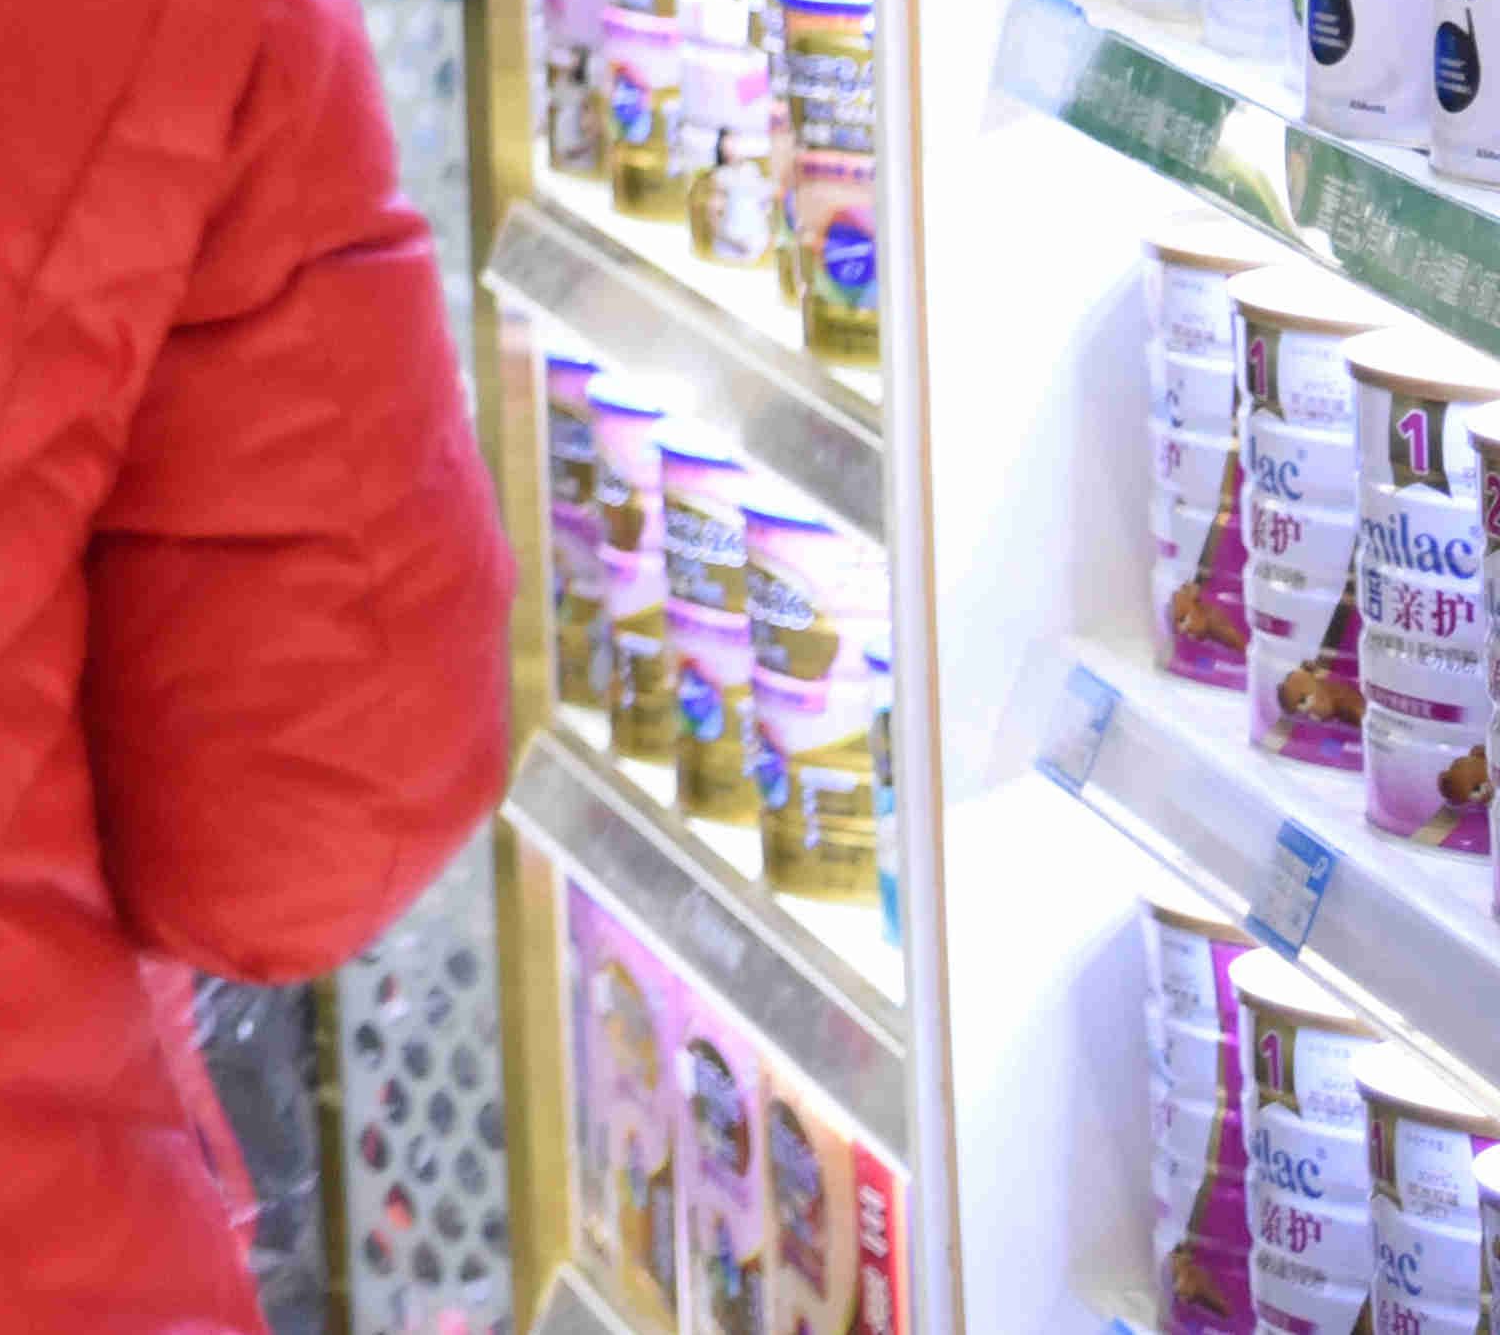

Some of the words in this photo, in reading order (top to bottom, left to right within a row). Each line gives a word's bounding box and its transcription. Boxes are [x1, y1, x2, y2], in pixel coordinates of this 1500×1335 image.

[1397, 409, 1432, 475] 1
[1393, 583, 1476, 639] 亲护
[1259, 1032, 1283, 1091] 1
